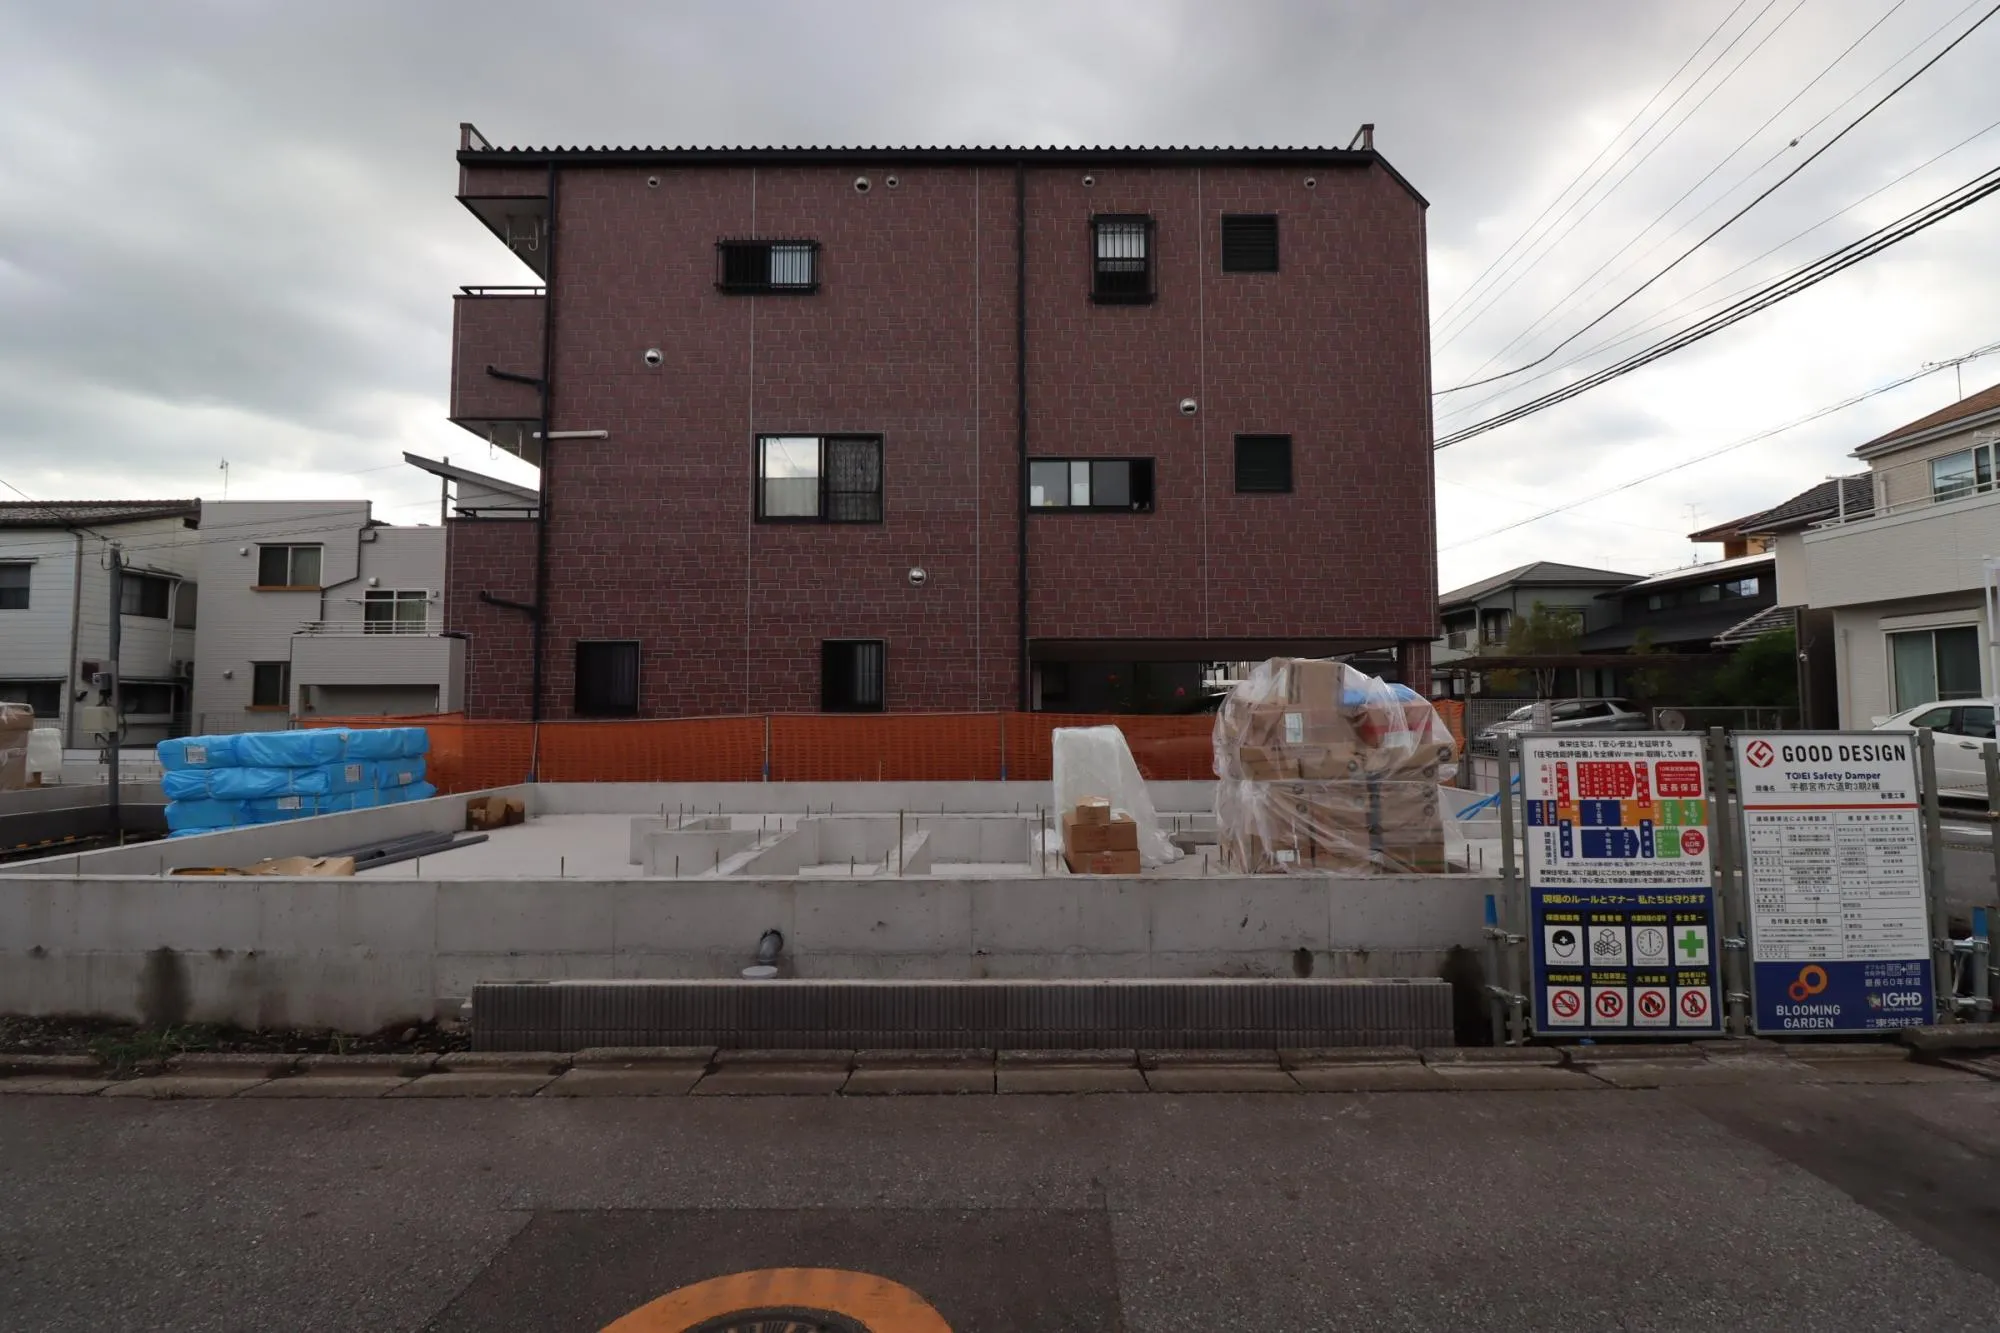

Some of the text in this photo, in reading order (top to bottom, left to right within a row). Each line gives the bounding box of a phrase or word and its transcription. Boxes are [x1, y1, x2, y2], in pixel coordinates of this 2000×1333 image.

[1782, 744, 1906, 763] GOOD DESIGN
[1813, 772, 1843, 782] Safety
[1845, 772, 1881, 781] Damper
[1542, 894, 1706, 904] 現場のルールとマナー 私たちは守ります
[1882, 992, 1922, 1006] IGHD
[1776, 1004, 1841, 1016] BLOOMING
[1783, 1017, 1834, 1028] GARDEN
